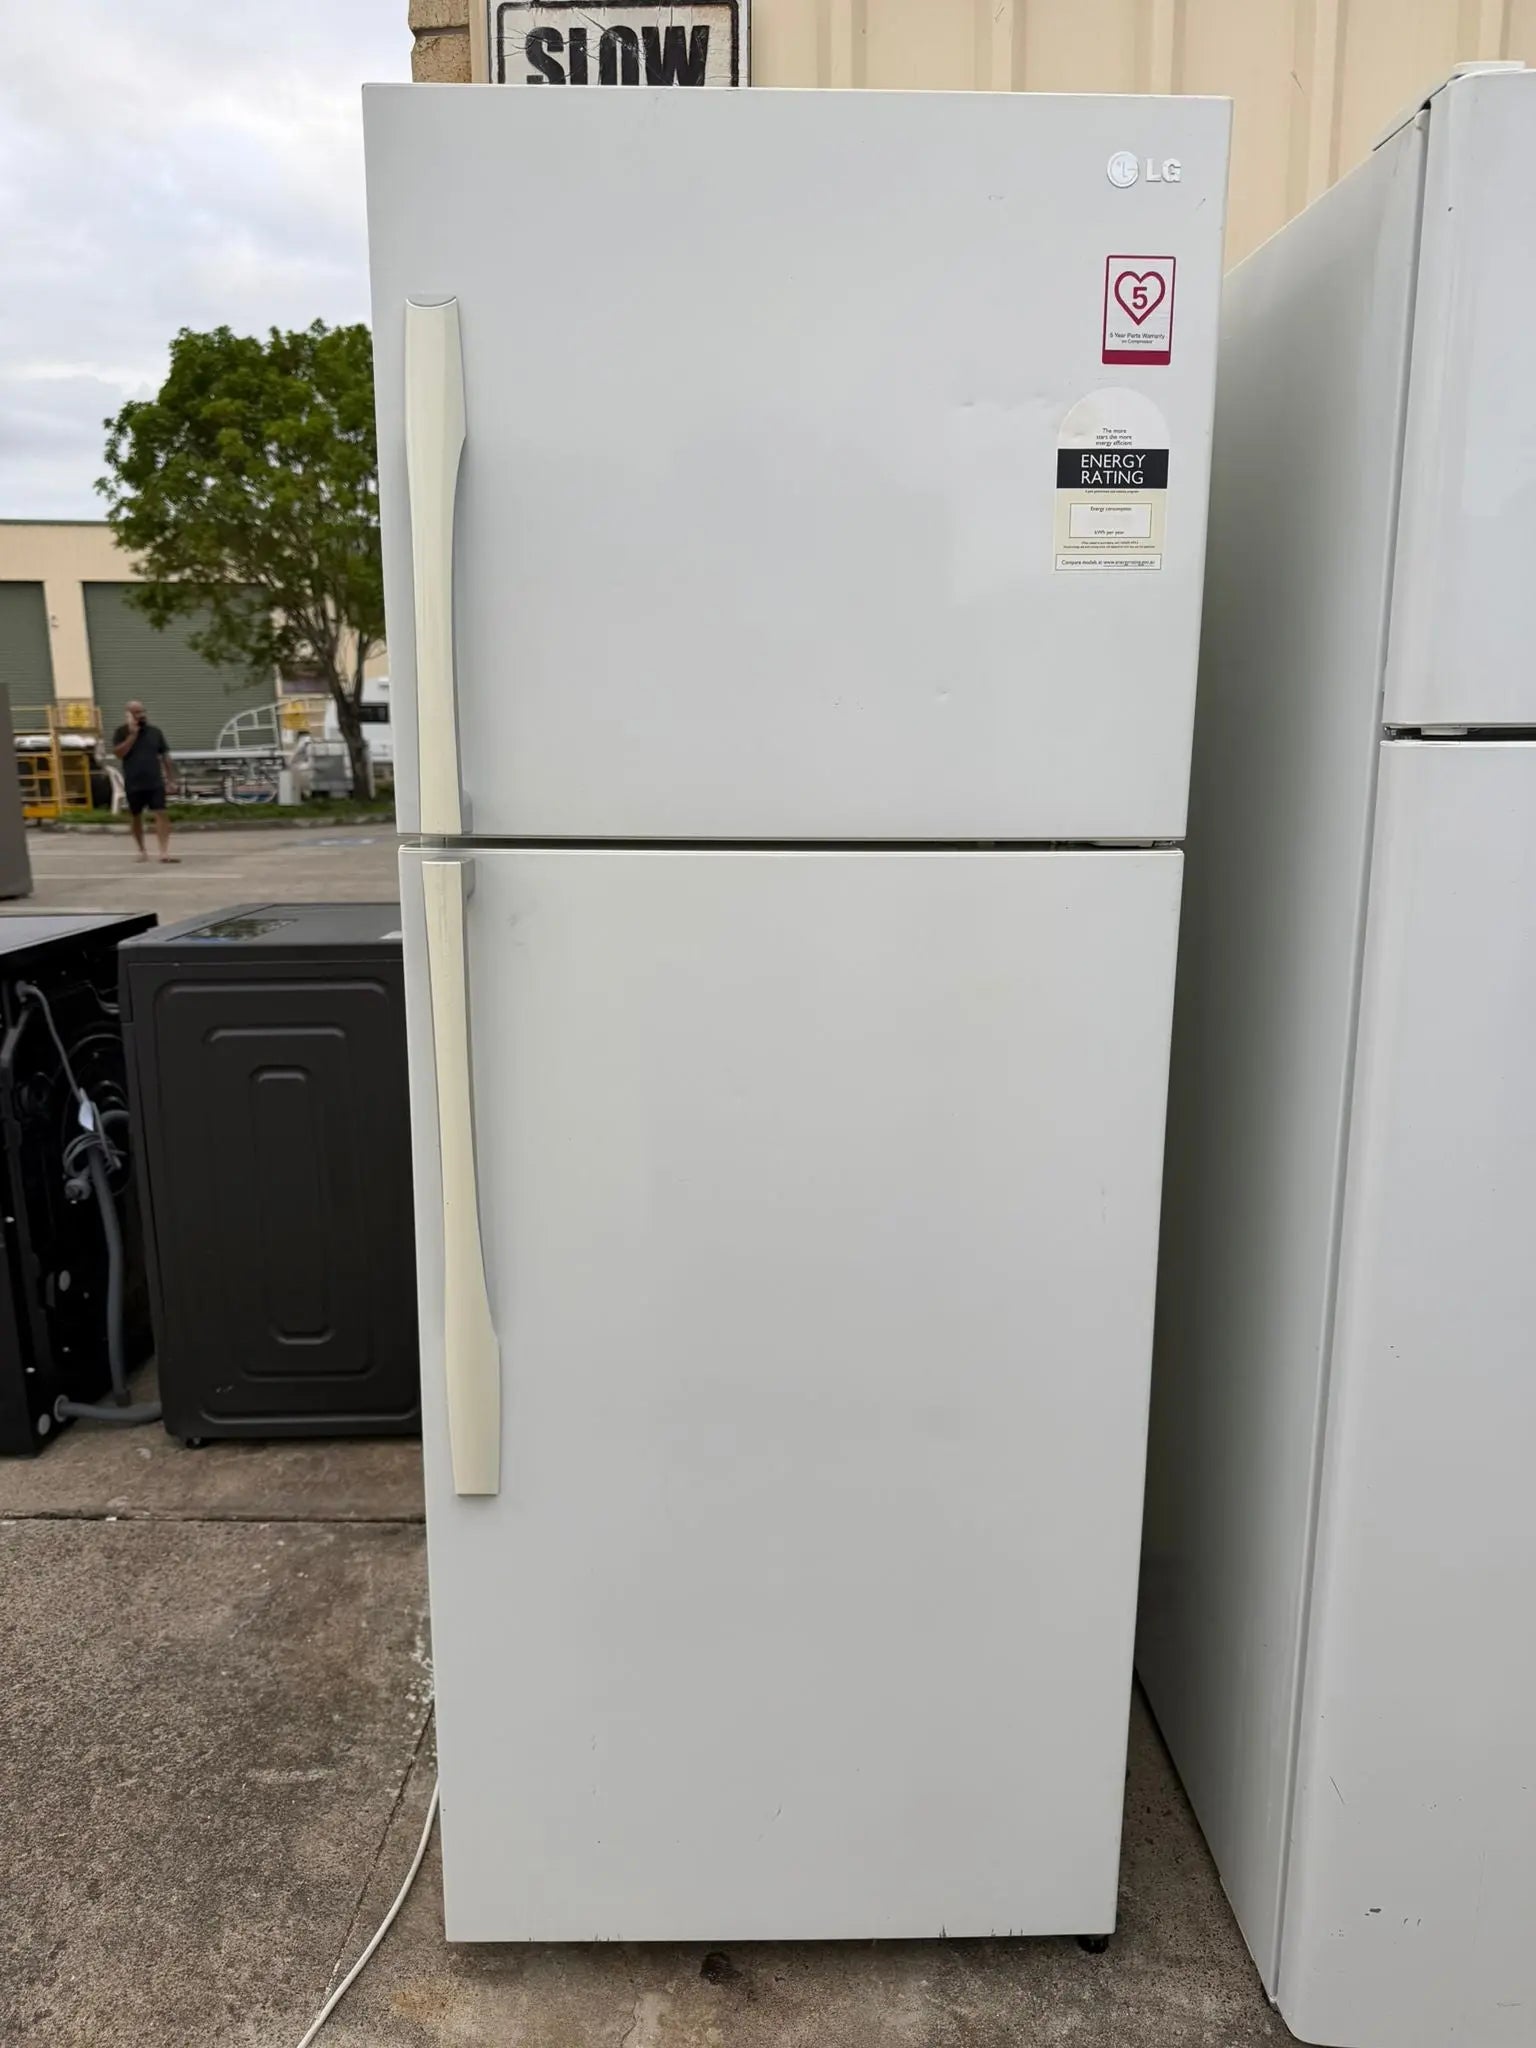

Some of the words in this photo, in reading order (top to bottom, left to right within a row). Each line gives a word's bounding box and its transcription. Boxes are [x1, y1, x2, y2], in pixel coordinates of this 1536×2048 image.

[1145, 158, 1182, 183] LG
[1132, 286, 1148, 310] 5
[1081, 454, 1146, 469] ENERGY
[1081, 470, 1144, 485] RATING
[1061, 559, 1082, 567] Compare
